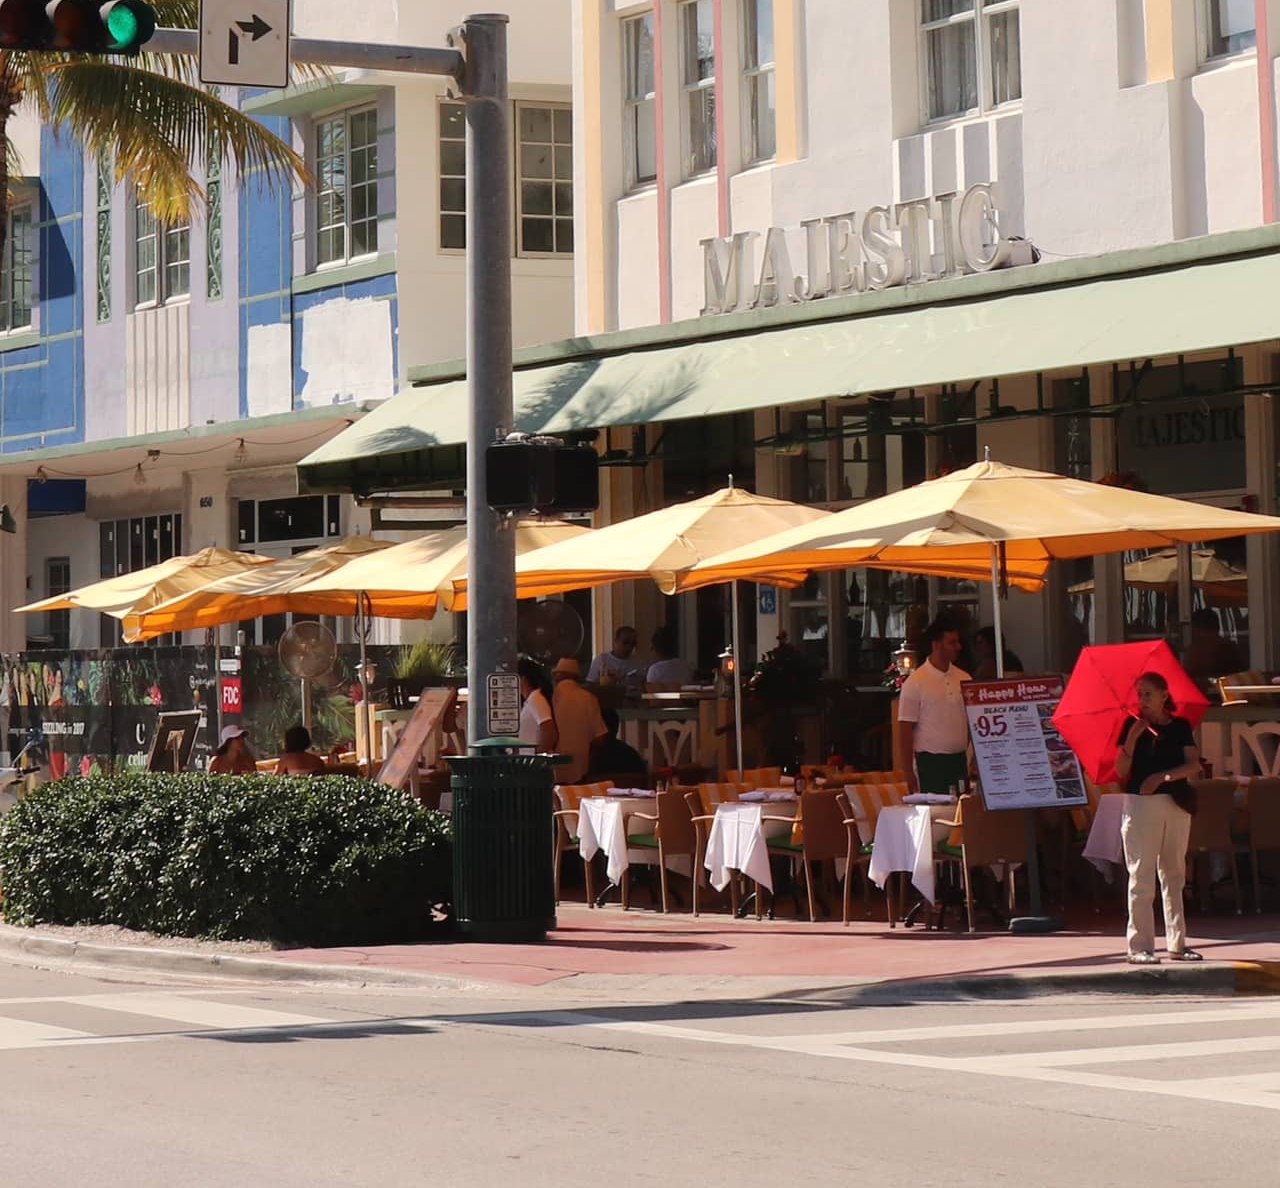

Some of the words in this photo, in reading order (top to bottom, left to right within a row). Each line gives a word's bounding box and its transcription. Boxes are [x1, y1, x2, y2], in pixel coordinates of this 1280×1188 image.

[699, 181, 1003, 316] MAJESTIC
[223, 686, 239, 705] FDC
[128, 751, 149, 767] celin
